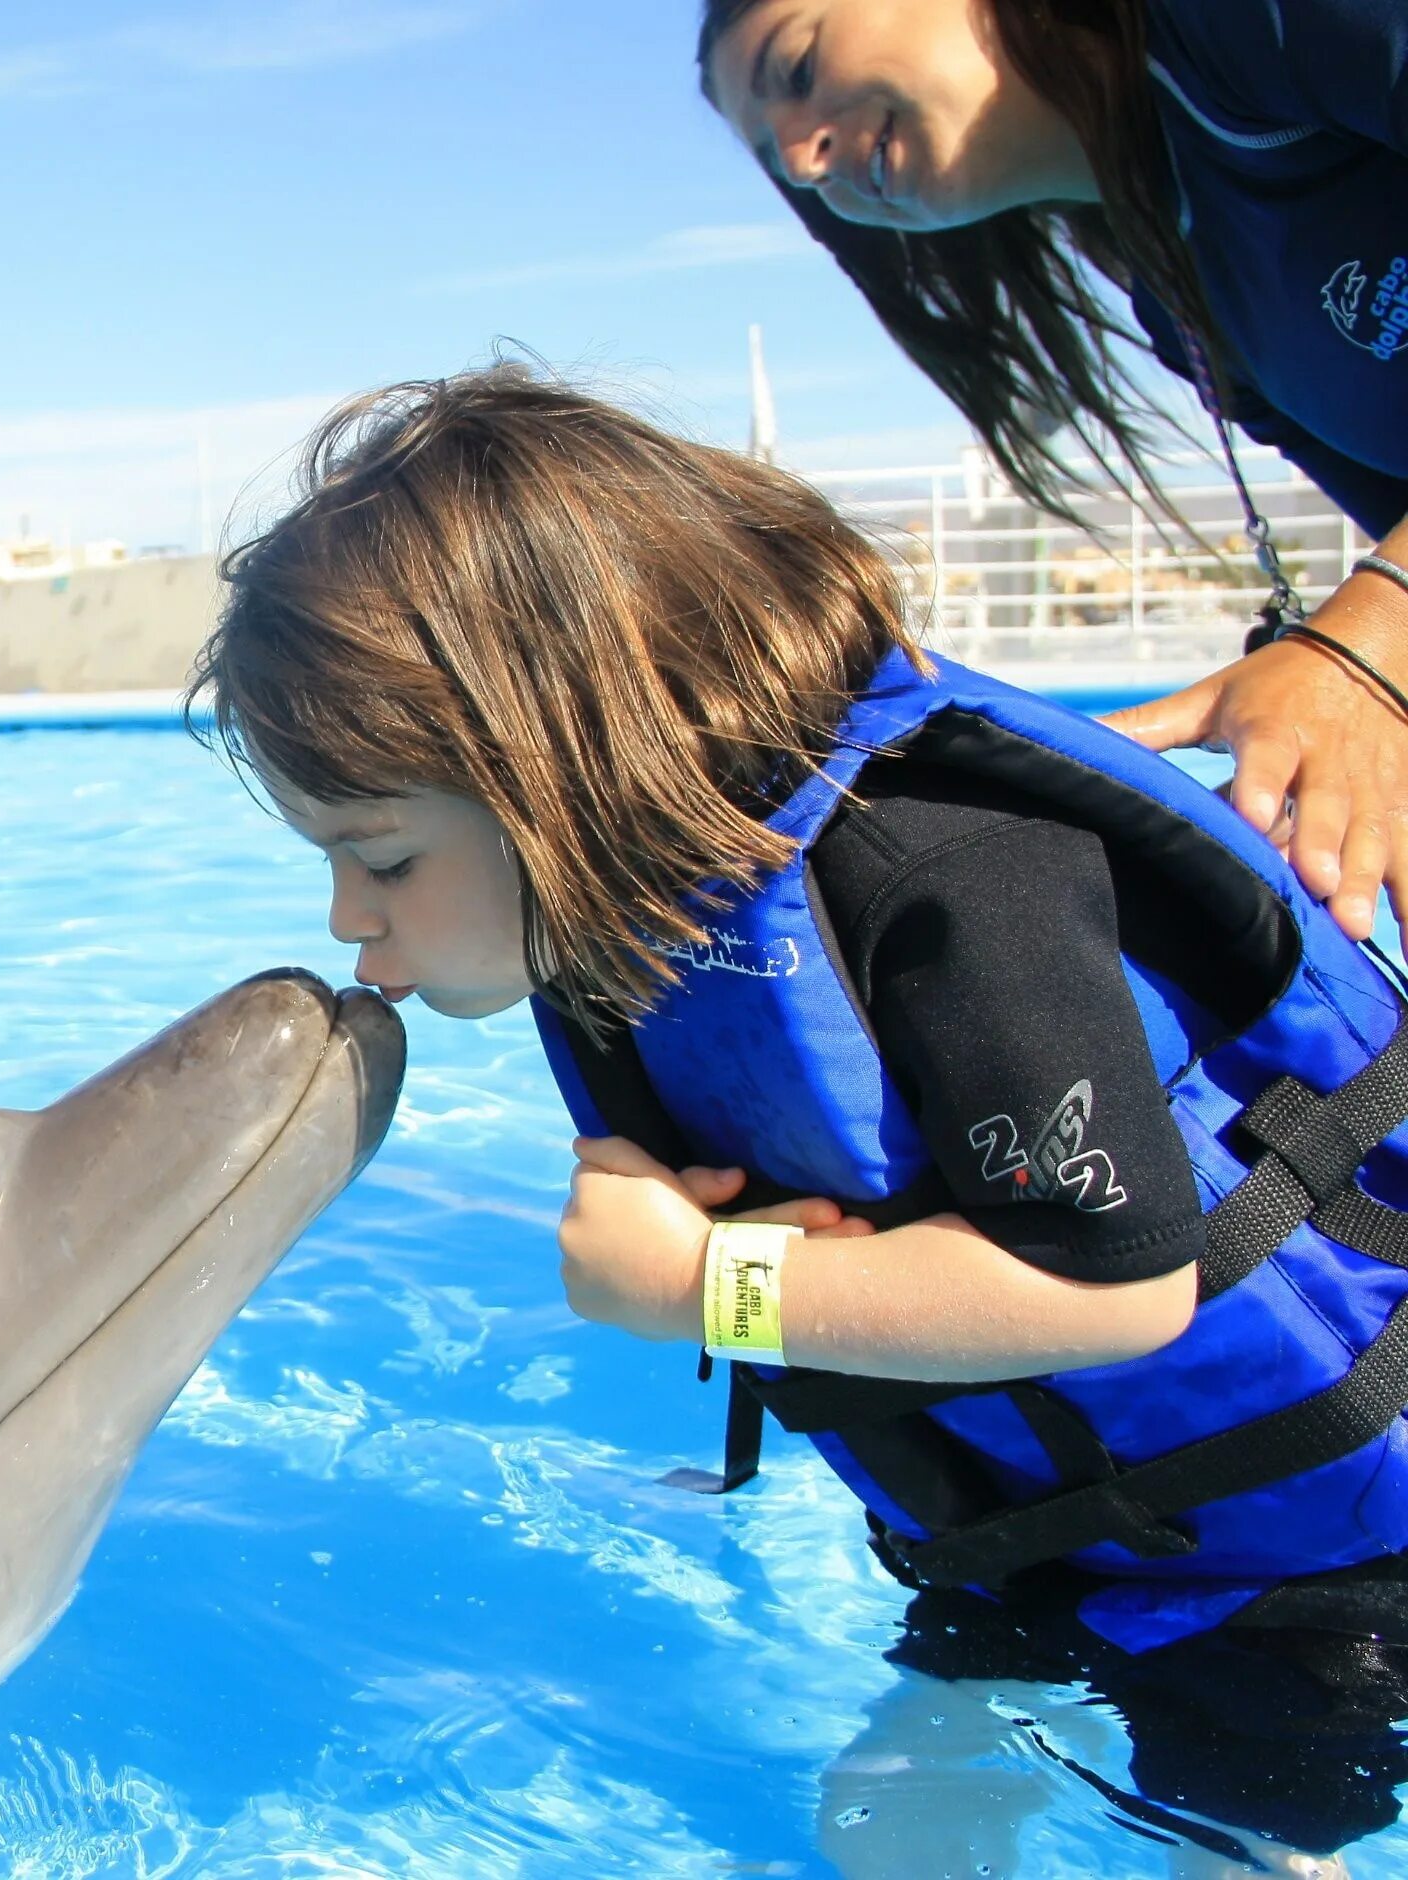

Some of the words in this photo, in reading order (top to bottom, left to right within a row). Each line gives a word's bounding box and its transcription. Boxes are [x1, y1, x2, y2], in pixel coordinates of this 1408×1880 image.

[1370, 257, 1407, 317] cabo
[969, 1114, 1029, 1181] 2
[1057, 1149, 1127, 1212] 2
[749, 1287, 761, 1316] CABO
